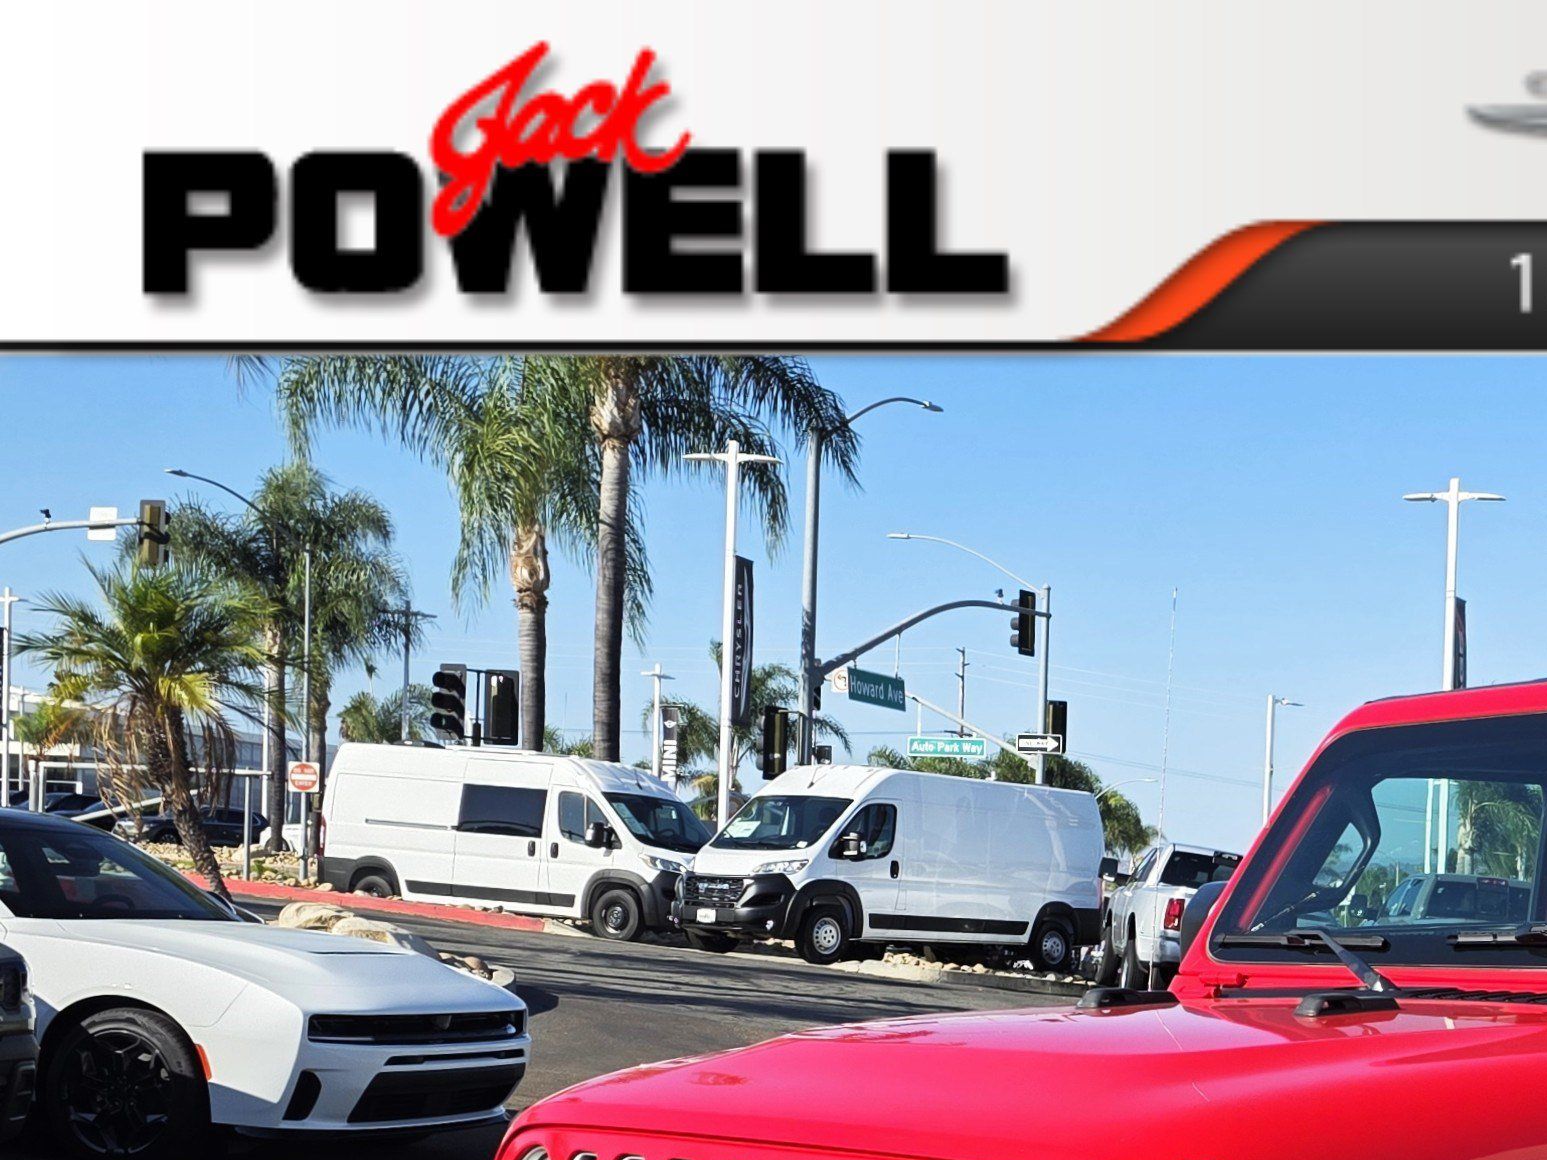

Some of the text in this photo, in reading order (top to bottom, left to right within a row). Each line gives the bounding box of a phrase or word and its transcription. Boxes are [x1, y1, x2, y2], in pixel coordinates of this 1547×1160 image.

[734, 583, 743, 699] CHRYSLER
[850, 675, 904, 704] Howard Ave
[661, 739, 678, 782] MINI
[911, 740, 983, 755] Auto Park Way
